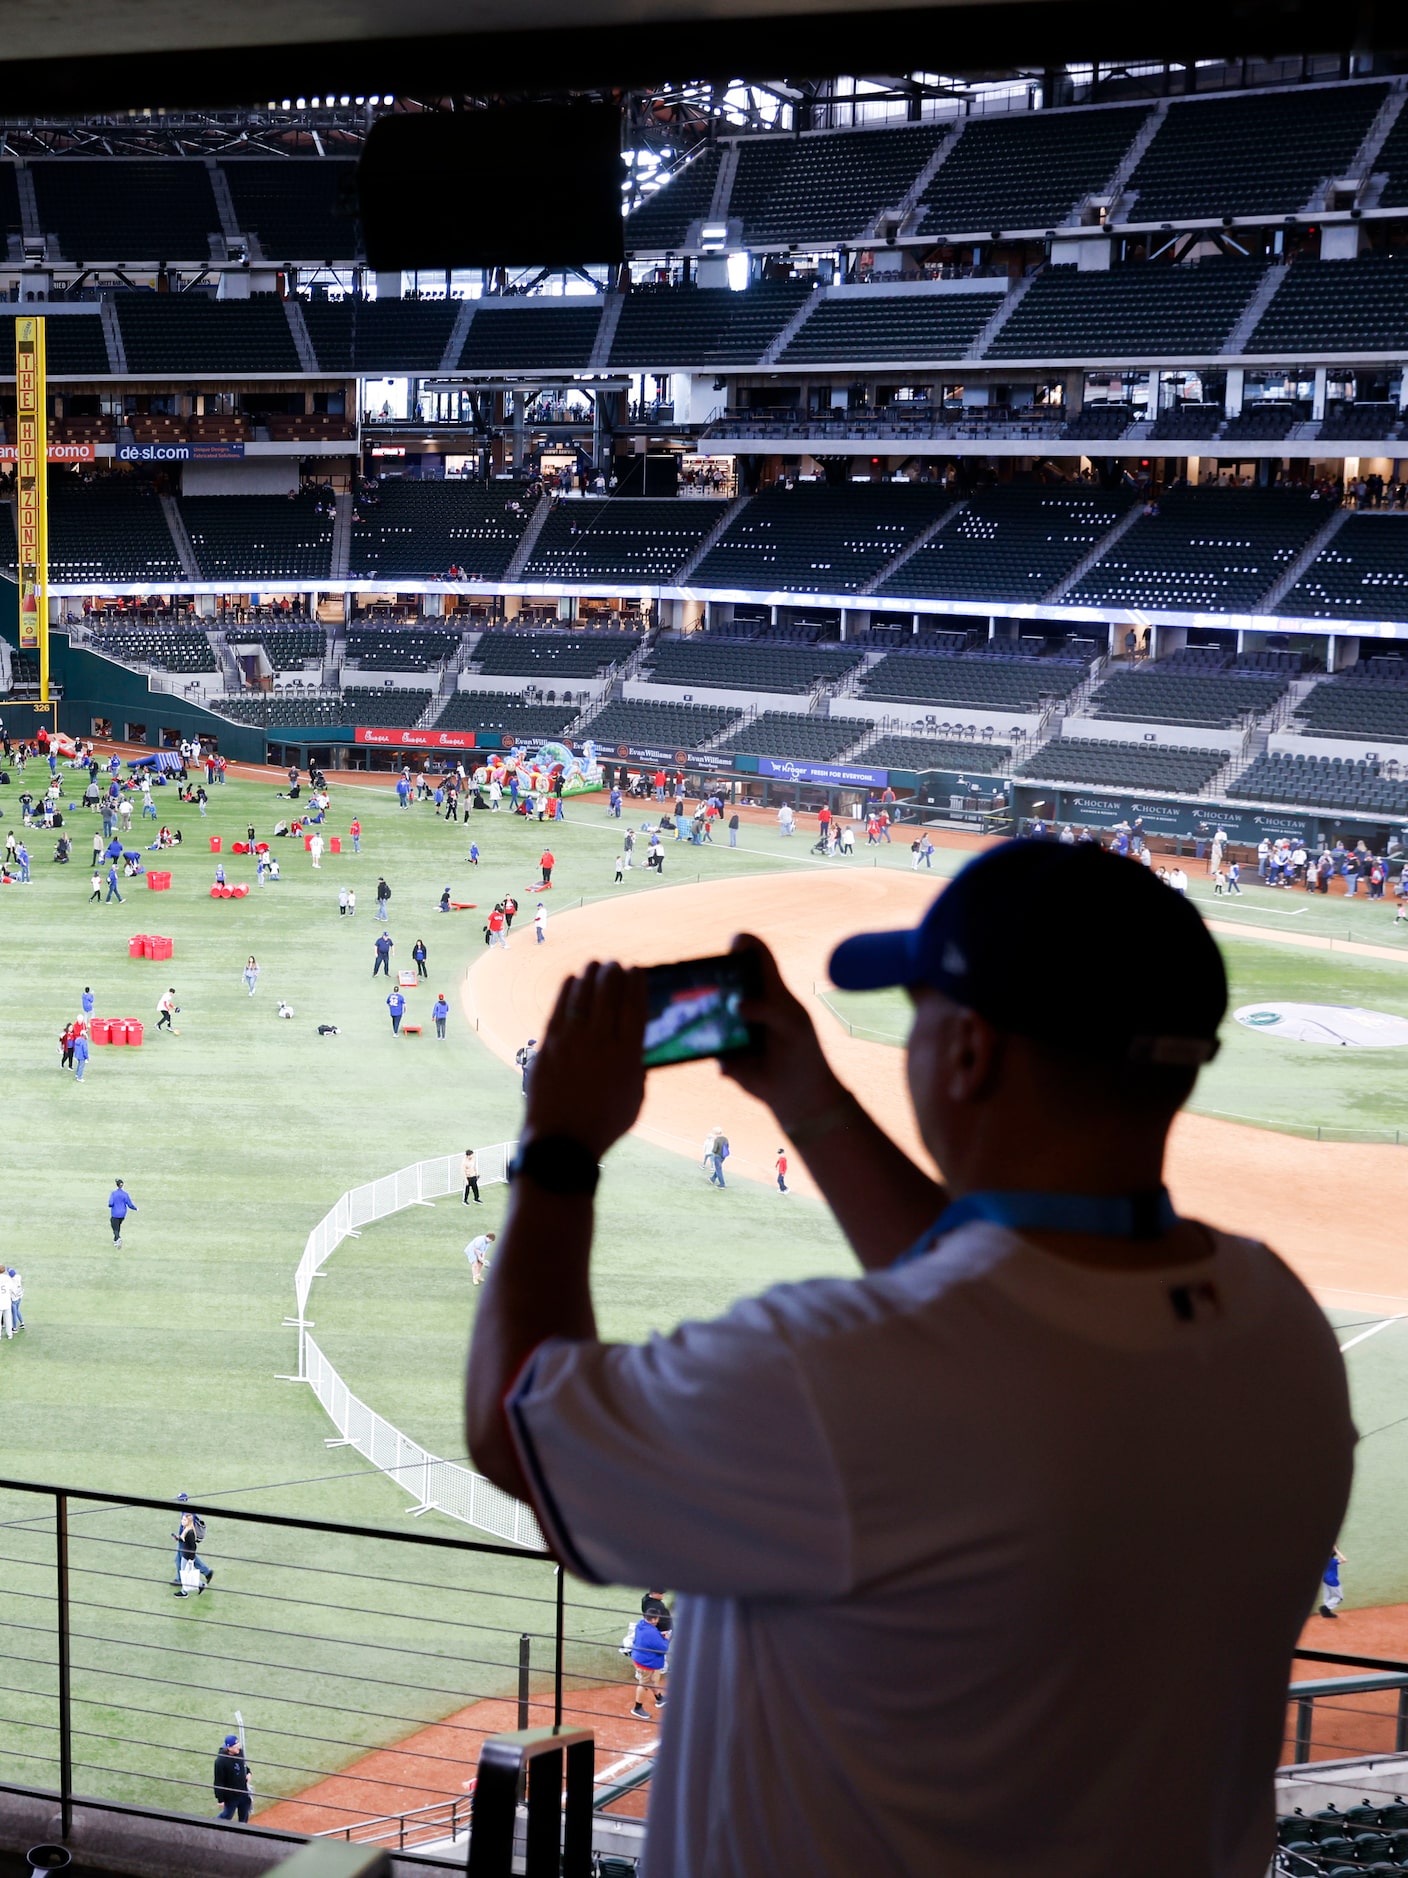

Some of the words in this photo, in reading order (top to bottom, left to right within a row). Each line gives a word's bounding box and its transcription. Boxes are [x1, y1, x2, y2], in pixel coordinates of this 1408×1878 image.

[22, 354, 32, 407] THE
[22, 423, 32, 473] HOT
[23, 492, 33, 562] ZONE
[33, 704, 50, 712] 326
[782, 762, 807, 777] Kroger
[1074, 798, 1121, 809] CHOCTAW
[1132, 804, 1179, 815] CHOCTAW
[1193, 809, 1242, 821] CHOCTAW
[1254, 816, 1305, 828] CHOCTAW
